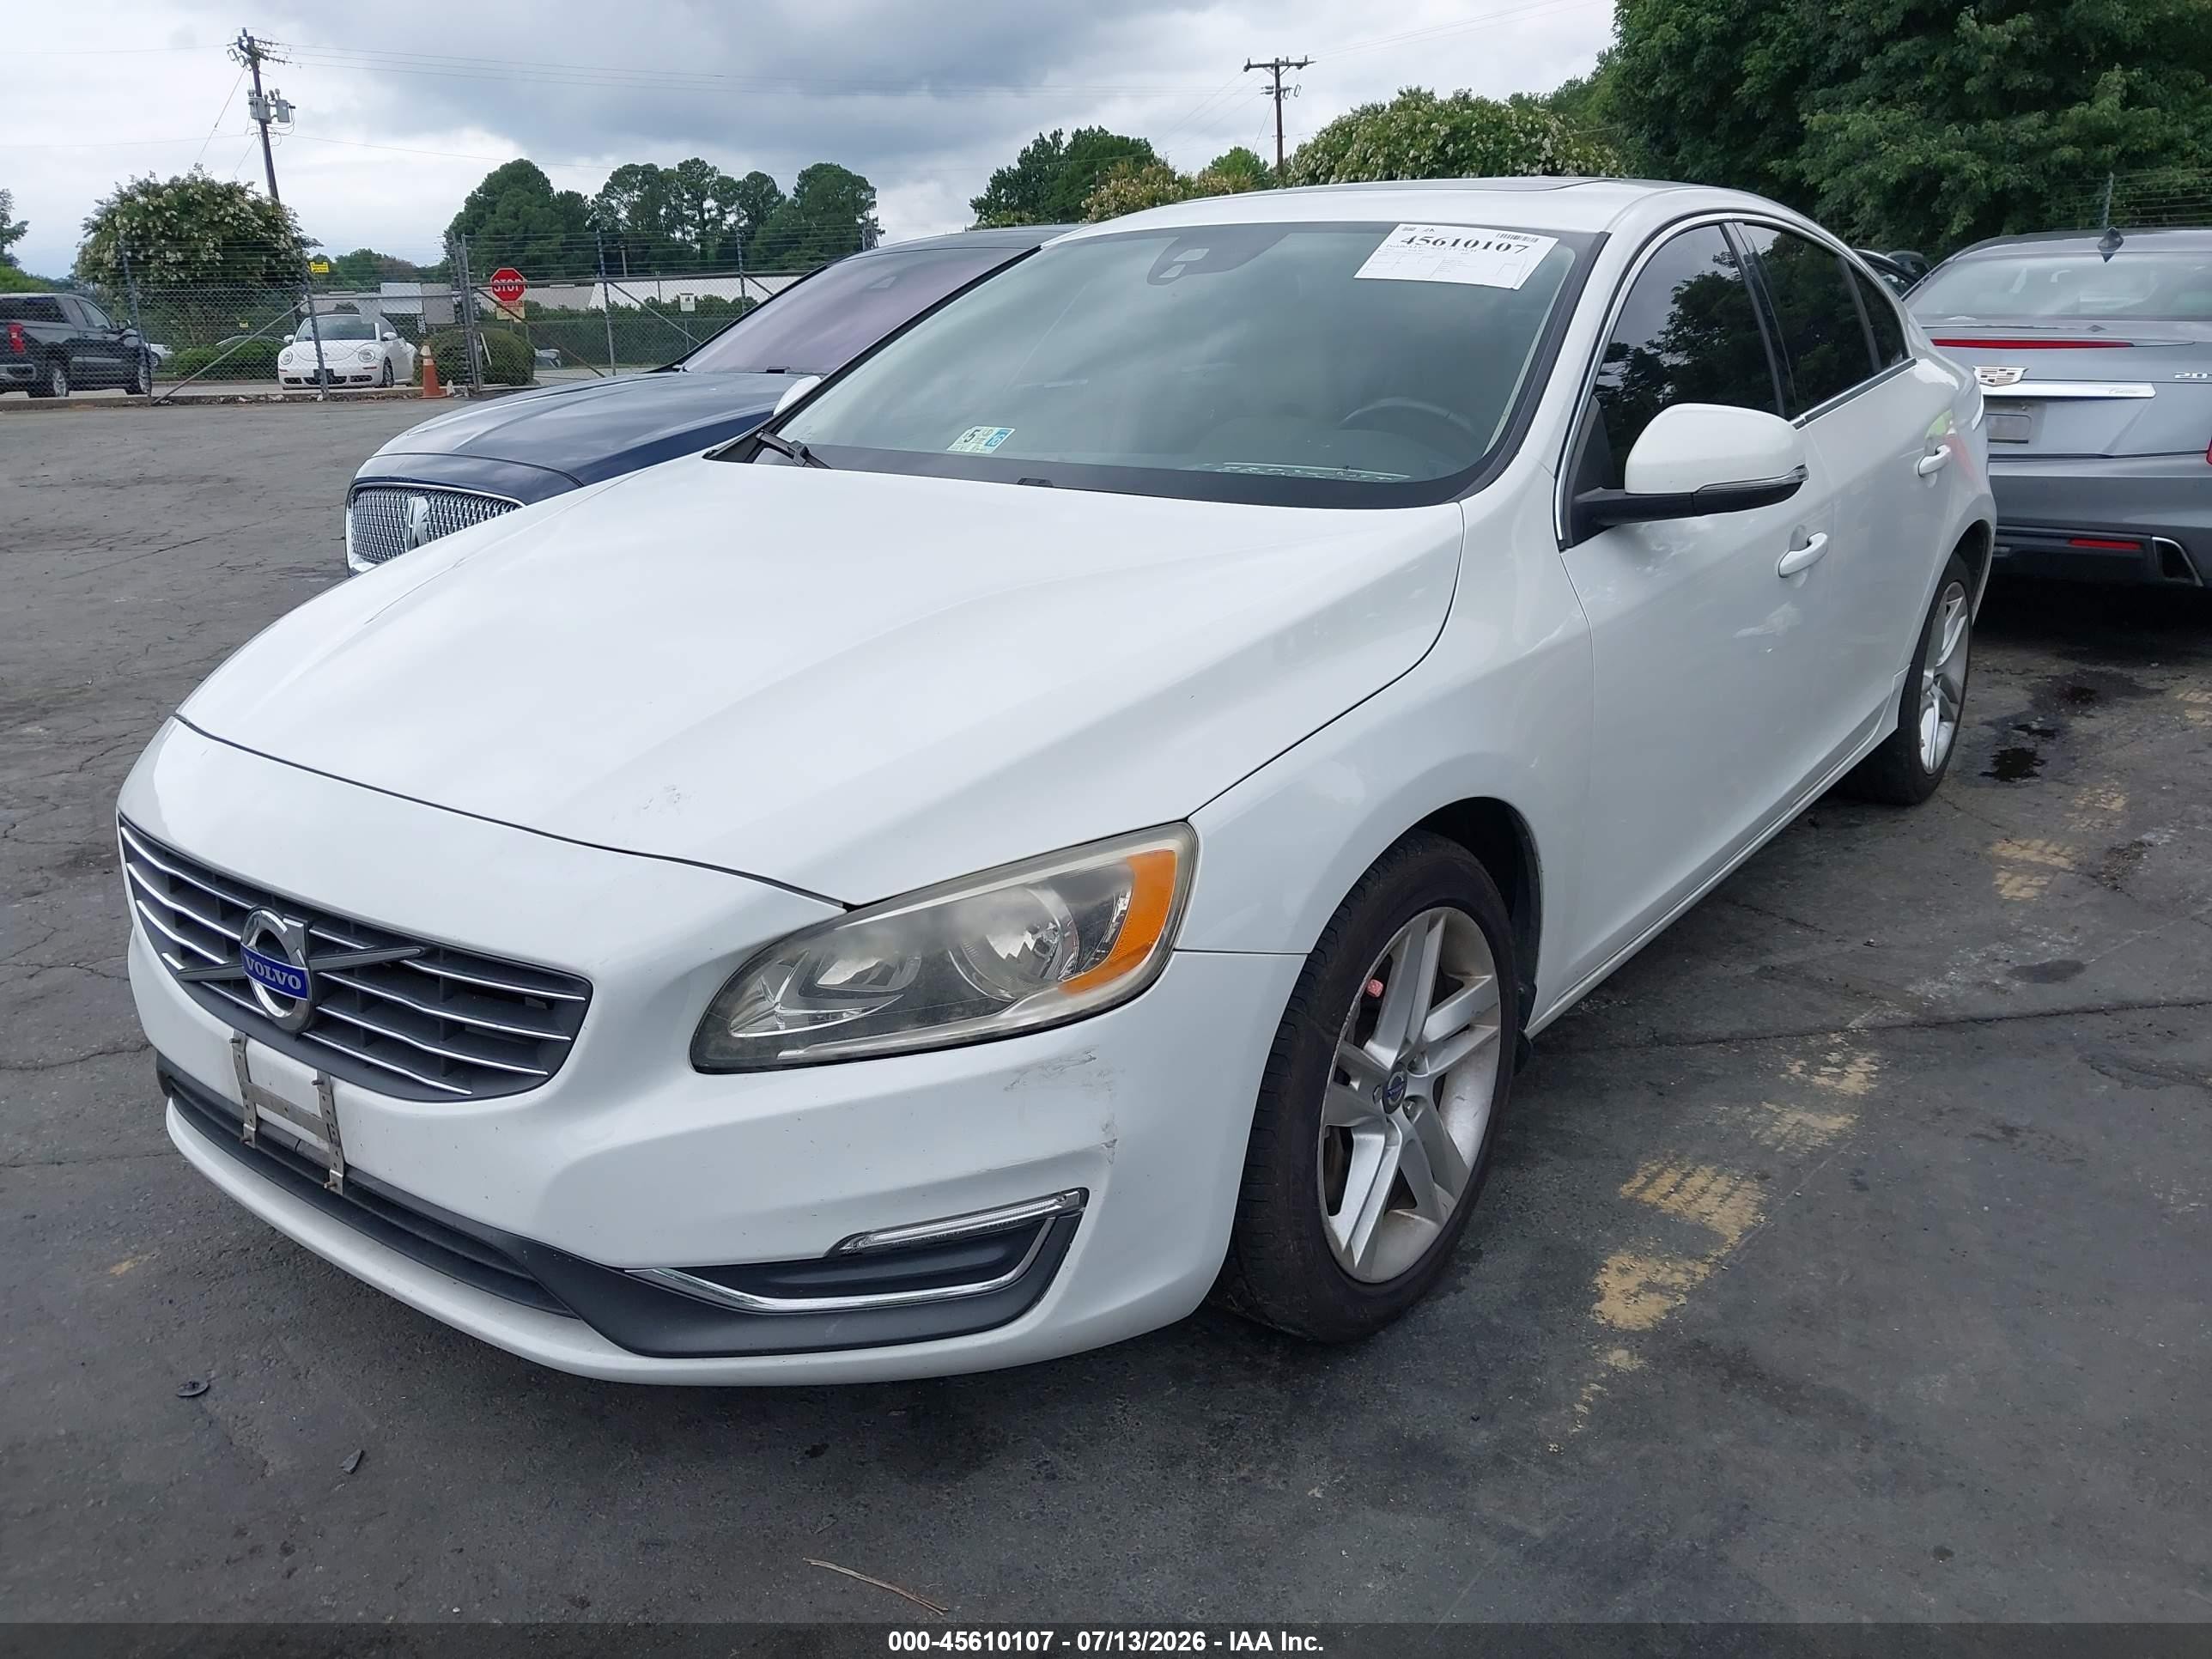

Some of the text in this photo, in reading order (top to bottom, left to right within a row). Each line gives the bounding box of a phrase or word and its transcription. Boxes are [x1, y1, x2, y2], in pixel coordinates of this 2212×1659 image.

[1401, 235, 1529, 254] 45610107
[494, 279, 521, 292] STOP
[244, 953, 301, 990] VOLVO
